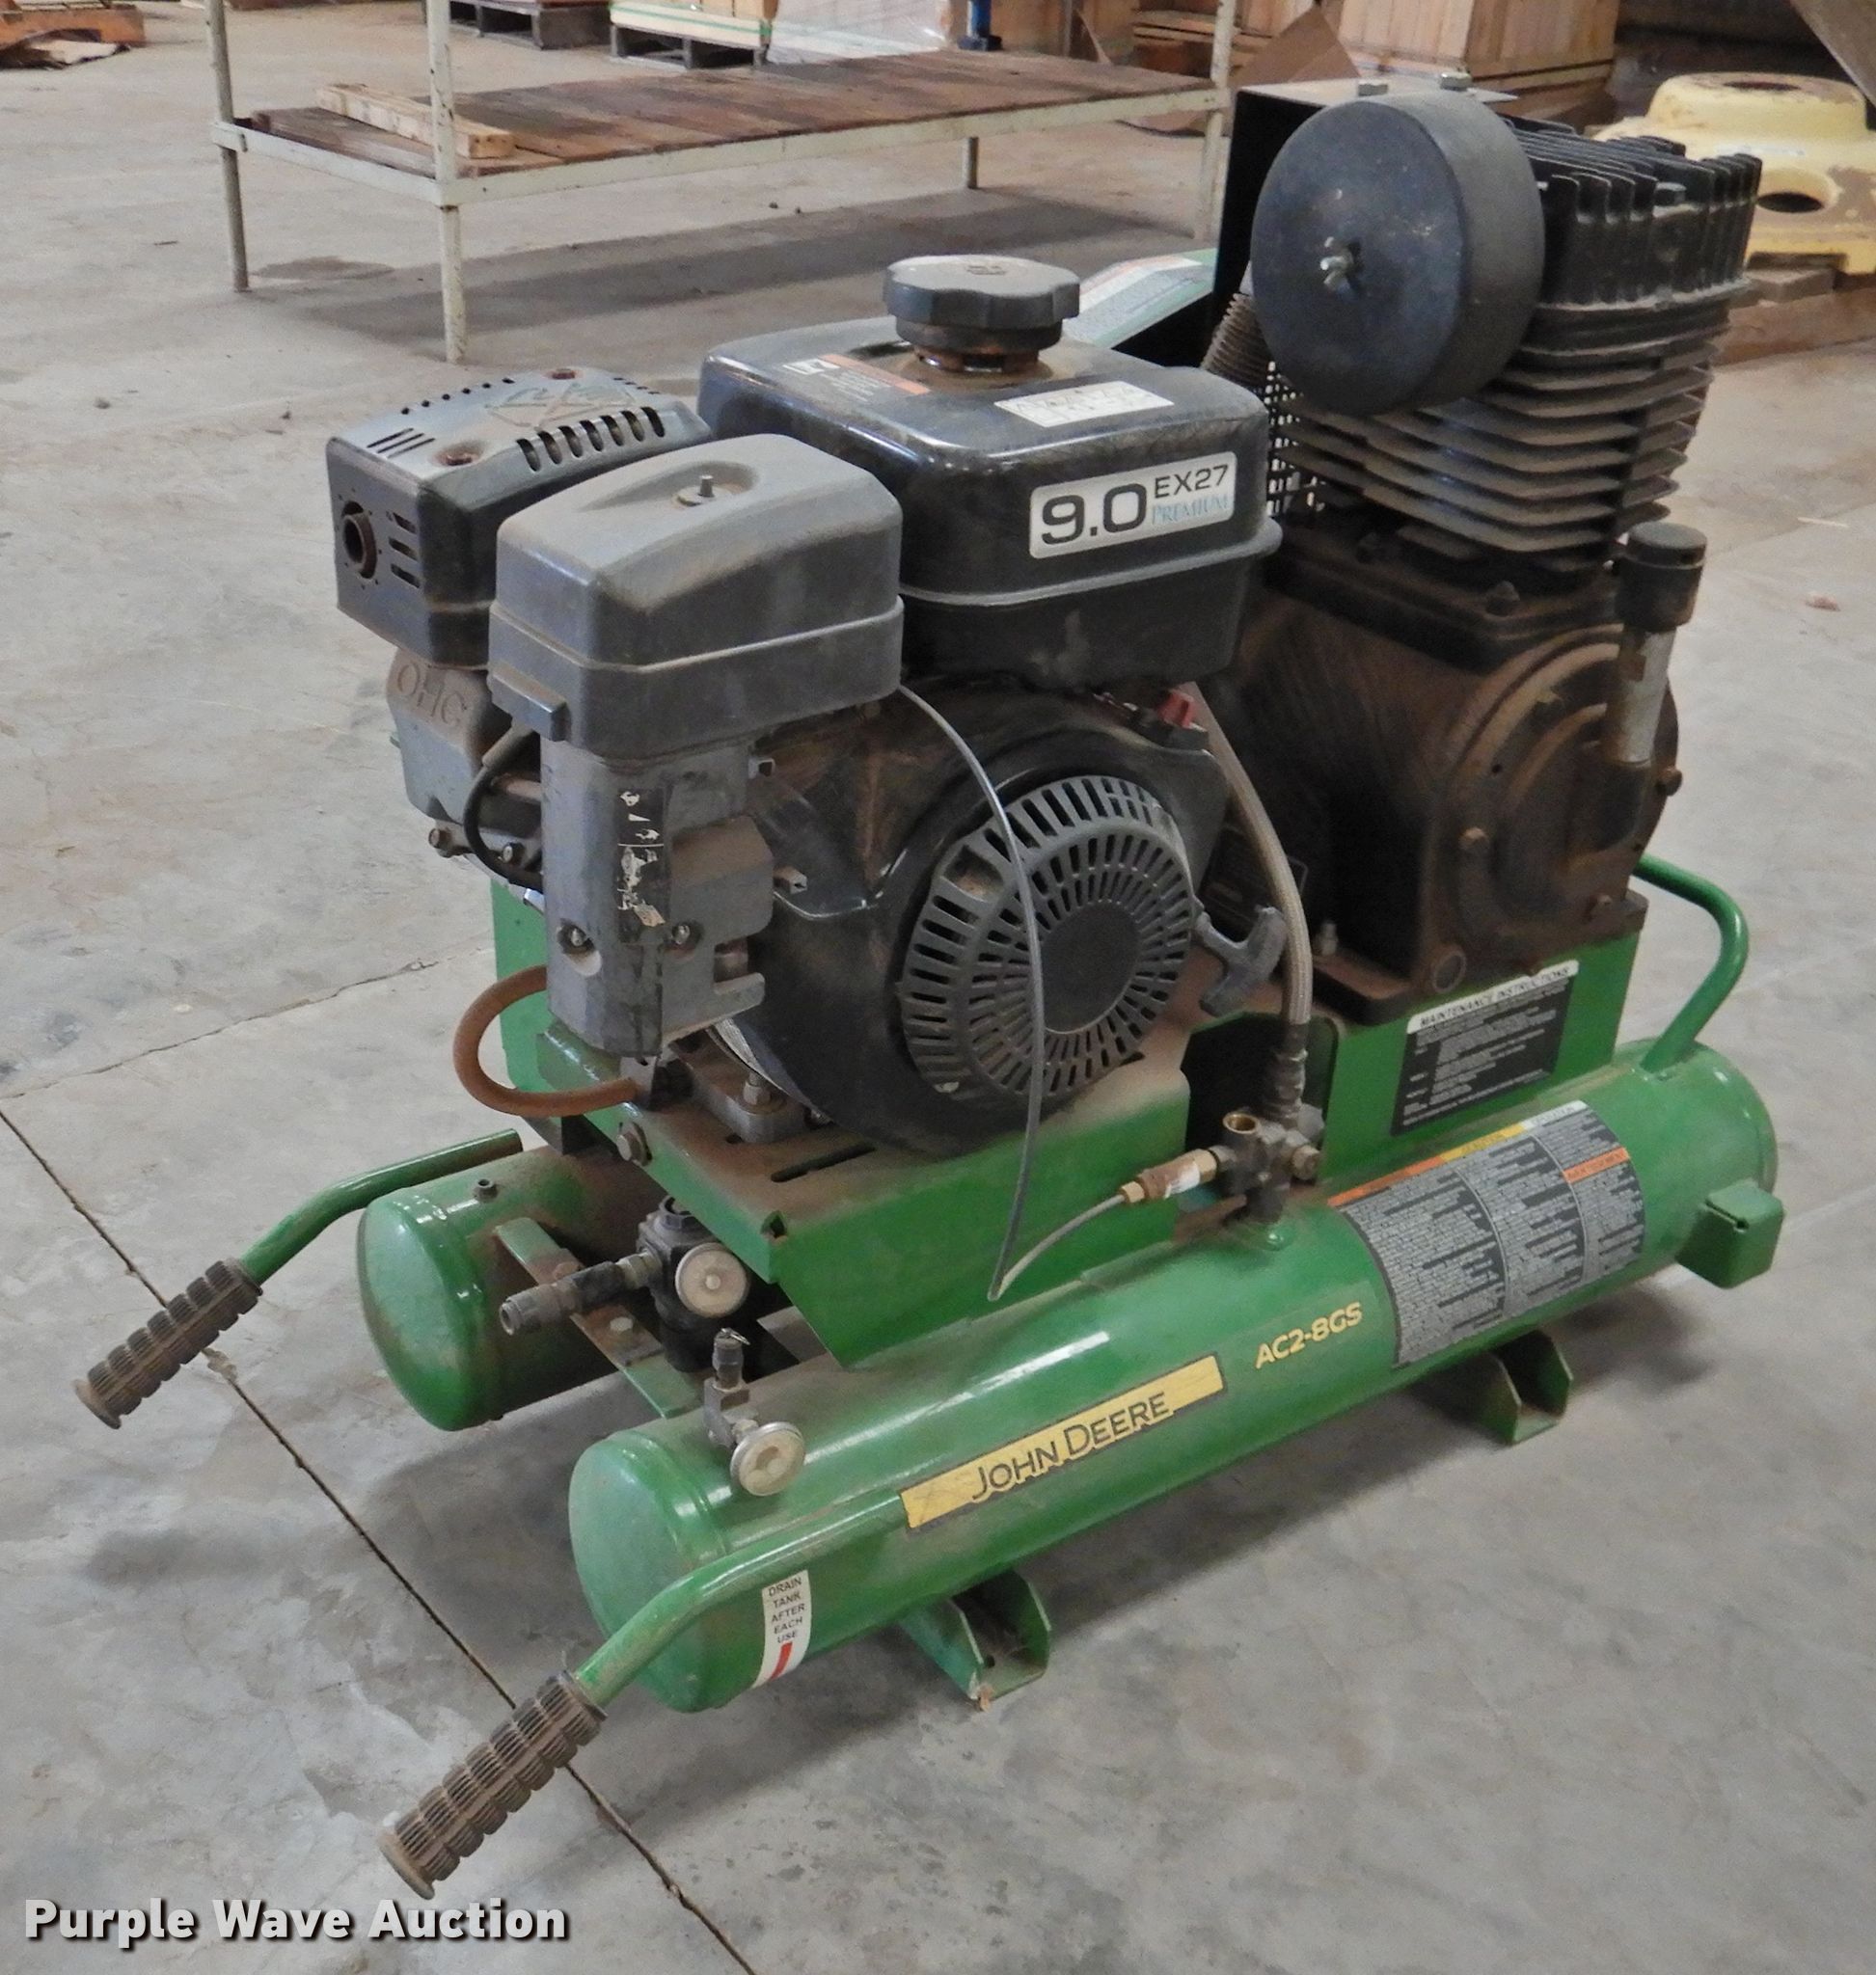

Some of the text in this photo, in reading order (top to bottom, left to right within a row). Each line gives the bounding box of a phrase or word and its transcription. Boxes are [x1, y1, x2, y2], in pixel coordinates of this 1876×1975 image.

[1154, 464, 1229, 499] EX27
[1041, 483, 1147, 545] 9.0
[1152, 494, 1231, 526] PREMIUM
[1255, 1301, 1362, 1369] AC2-8GS
[972, 1392, 1170, 1501] JOHN DEERE
[769, 1577, 802, 1596] DRAIN
[772, 1603, 805, 1622] AFTER
[774, 1592, 801, 1609] TANK
[774, 1616, 802, 1634] EACH
[777, 1631, 797, 1643] USE
